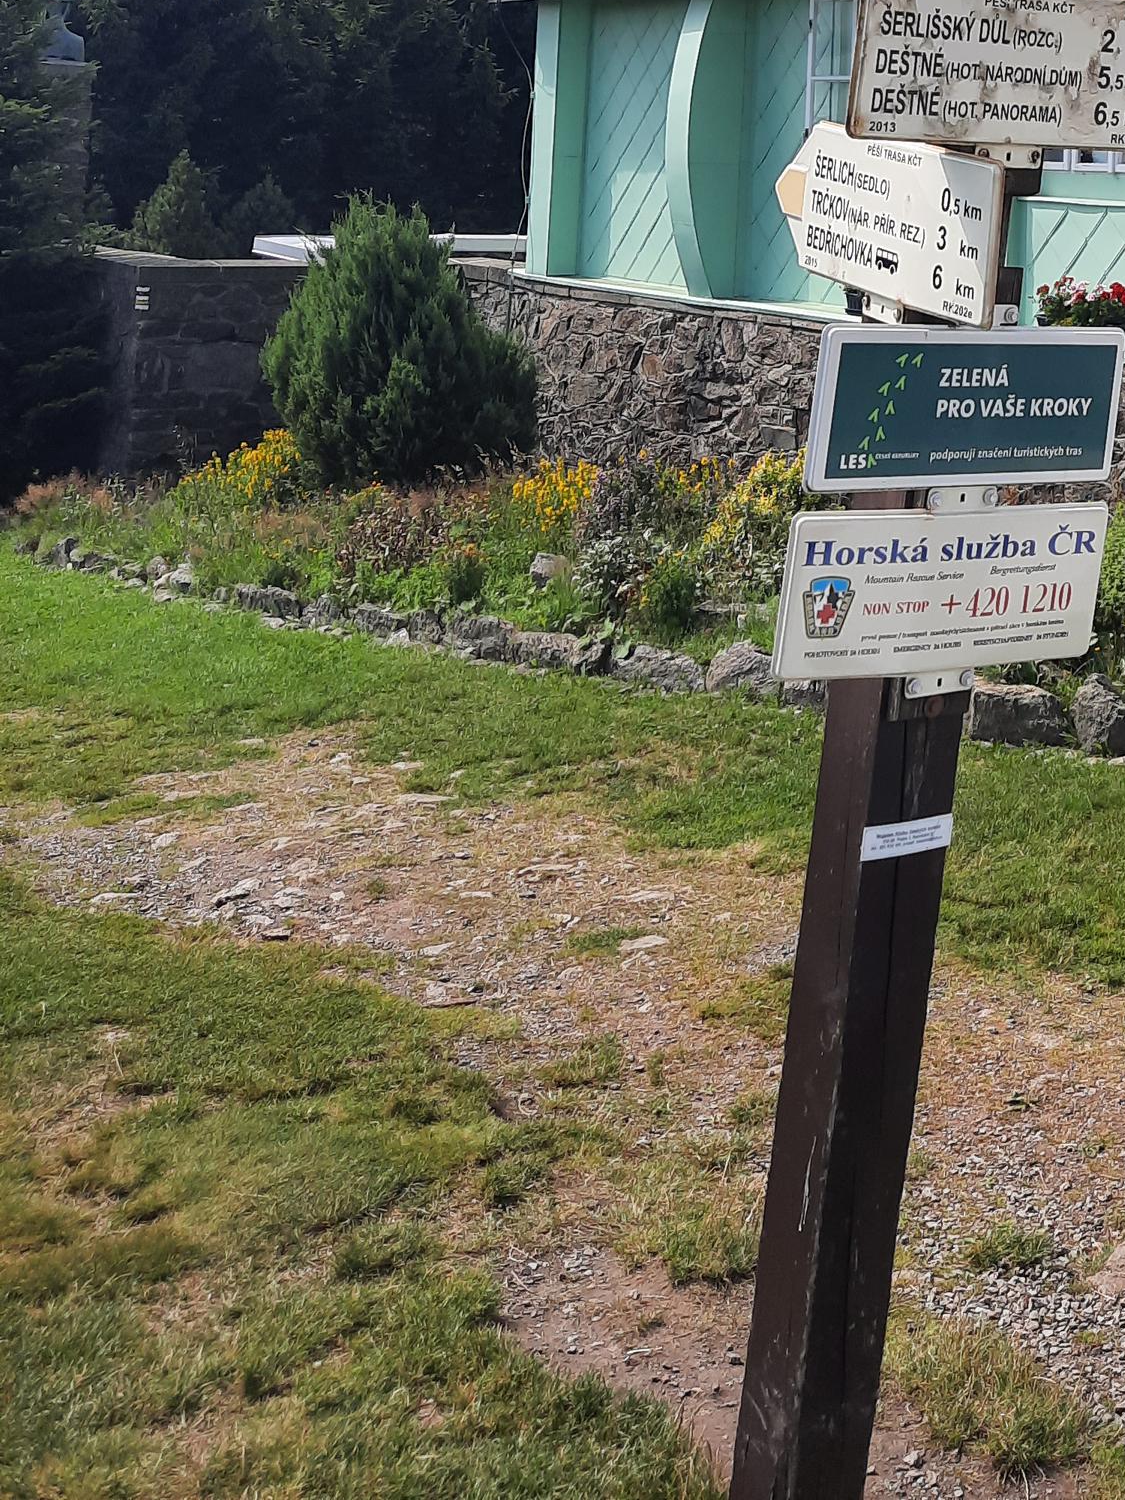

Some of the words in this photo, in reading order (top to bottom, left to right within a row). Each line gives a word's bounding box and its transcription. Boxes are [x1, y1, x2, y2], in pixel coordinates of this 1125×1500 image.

[1052, 1, 1075, 14] KČT
[880, 6, 976, 42] ŠERLIŠSKÝ
[979, 14, 1011, 45] DŮL
[875, 48, 944, 77] DEŠTNÉ
[985, 62, 1048, 88] NÁRODNÍ
[1098, 66, 1124, 91] 5,5
[871, 87, 940, 116] DEŠTNÉ
[982, 102, 1062, 127] PANORAMA)
[1094, 102, 1120, 126] 6,5
[869, 121, 896, 132] 2013
[867, 144, 882, 157] PĚŠÍ
[884, 150, 906, 164] TRASA
[907, 155, 922, 167] KČT
[941, 188, 960, 215] 0,5
[963, 203, 981, 221] km
[873, 215, 897, 238] PŘÍR.
[900, 224, 925, 249] REZ.)
[936, 226, 947, 250] 3
[960, 240, 978, 260] km
[806, 224, 873, 268] BEDŘICHOVKA
[932, 265, 942, 289] 6
[955, 279, 974, 300] km
[942, 301, 973, 318] RK202e
[939, 365, 1009, 388] ZELENÁ
[936, 398, 977, 418] PRO
[981, 395, 1024, 418] VAŠE
[1029, 398, 1092, 416] KROKY
[978, 446, 1011, 458] značení
[1014, 445, 1063, 459] turistických
[1066, 447, 1082, 456] tras
[802, 538, 928, 567] Horská
[941, 533, 1036, 562] služba
[1048, 524, 1096, 556] ČR
[865, 574, 903, 584] Mountain
[937, 571, 964, 581] Service
[862, 602, 890, 615] NON
[895, 601, 929, 614] STOP
[1019, 581, 1072, 613] 1210
